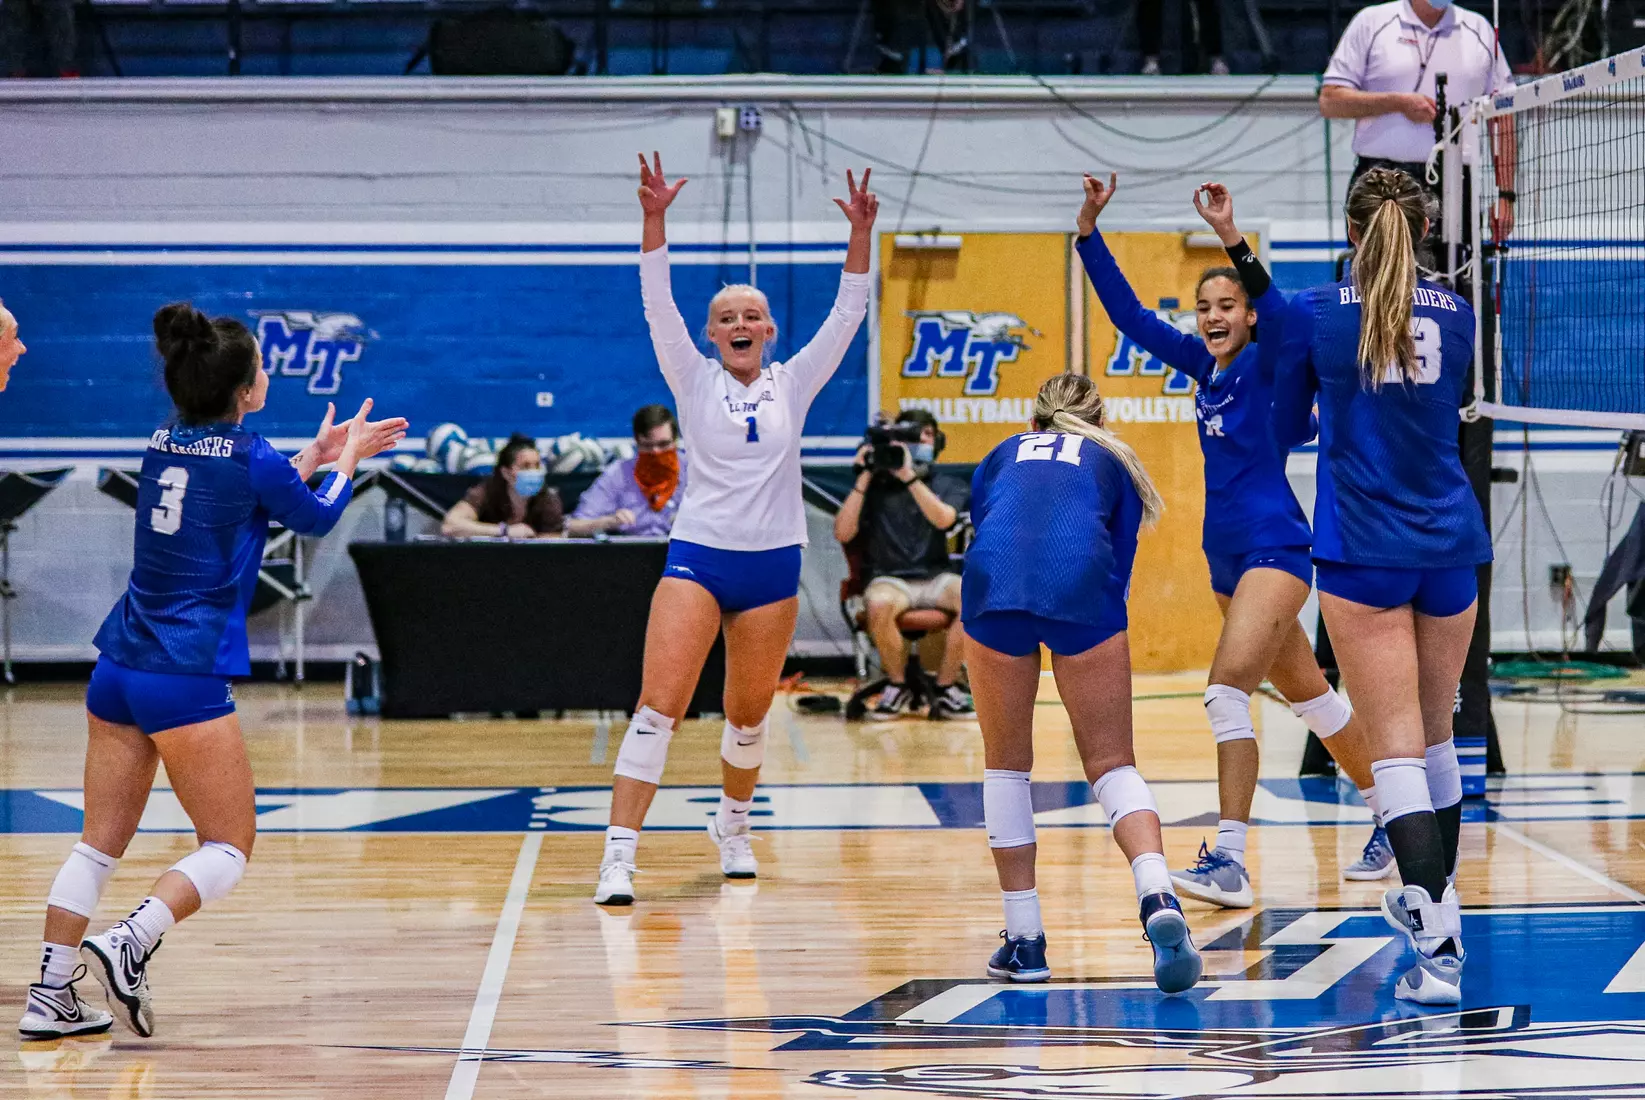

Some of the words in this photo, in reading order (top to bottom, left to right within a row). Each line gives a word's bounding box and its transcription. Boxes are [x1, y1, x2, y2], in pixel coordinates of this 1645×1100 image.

[1339, 286, 1362, 305] BL
[1411, 287, 1458, 312] IDERS
[258, 315, 362, 395] MT
[902, 316, 1020, 396] MT
[1380, 316, 1442, 385] 3
[745, 416, 759, 443] 1
[1103, 397, 1197, 423] VOLLEYB
[1015, 433, 1085, 467] 21
[151, 466, 190, 535] 3
